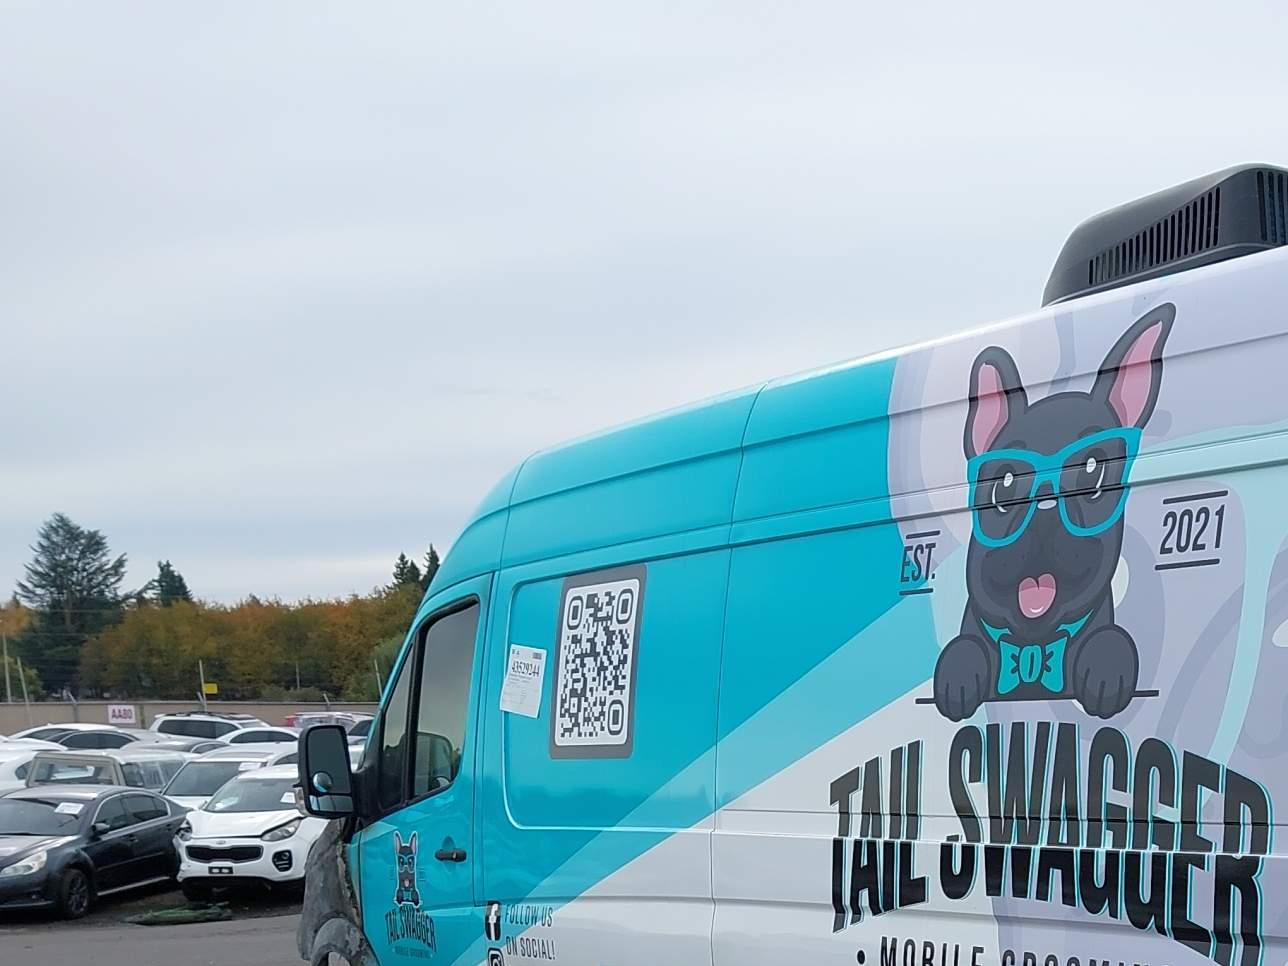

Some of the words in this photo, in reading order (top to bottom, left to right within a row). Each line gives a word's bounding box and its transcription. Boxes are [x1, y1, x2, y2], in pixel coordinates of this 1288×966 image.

[1160, 504, 1226, 555] 2021
[901, 542, 937, 583] EST.
[829, 740, 929, 934] TAIL
[386, 909, 400, 944] TAIL
[401, 905, 437, 952] SWAGGER
[505, 904, 539, 926] FOLLOW
[540, 907, 553, 927] US
[506, 936, 518, 955] ON
[520, 937, 556, 960] SOCIAL!
